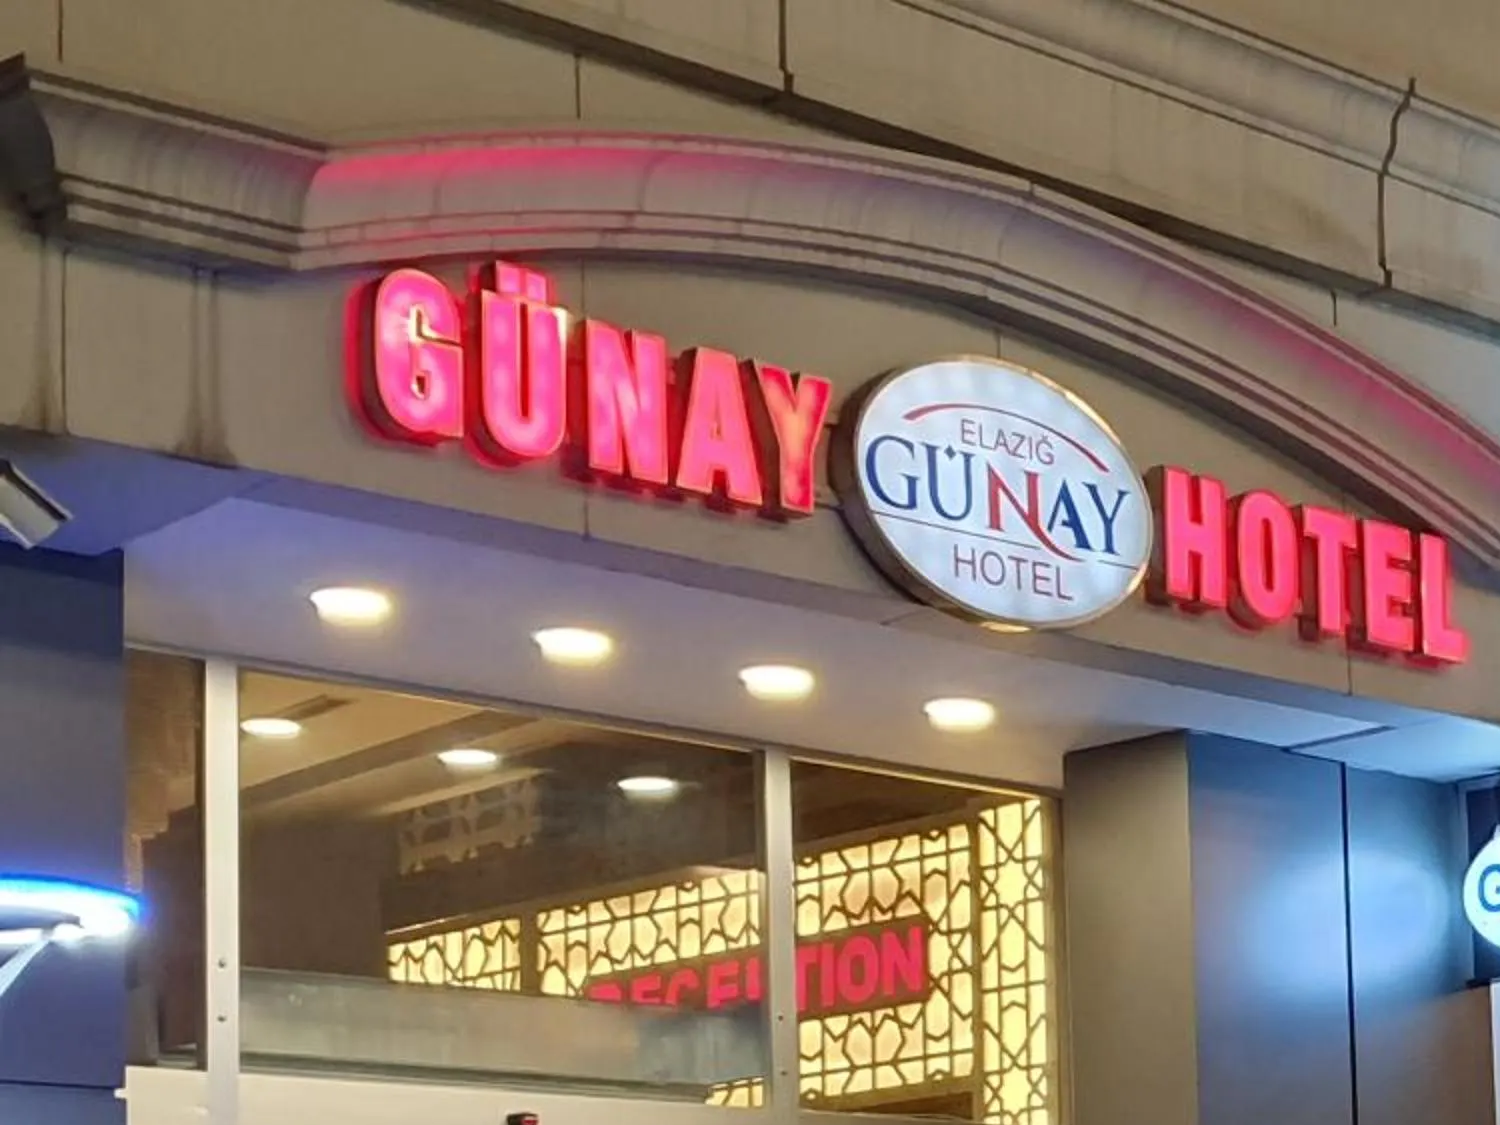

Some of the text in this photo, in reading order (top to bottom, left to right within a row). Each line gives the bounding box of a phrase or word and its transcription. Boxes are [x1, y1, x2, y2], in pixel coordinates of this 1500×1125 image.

[370, 259, 1468, 665] GÜNAY HOTEL
[959, 417, 1055, 467] ELAZIĞ
[864, 433, 1131, 562] GÜNAY
[952, 542, 1074, 602] HOTEL
